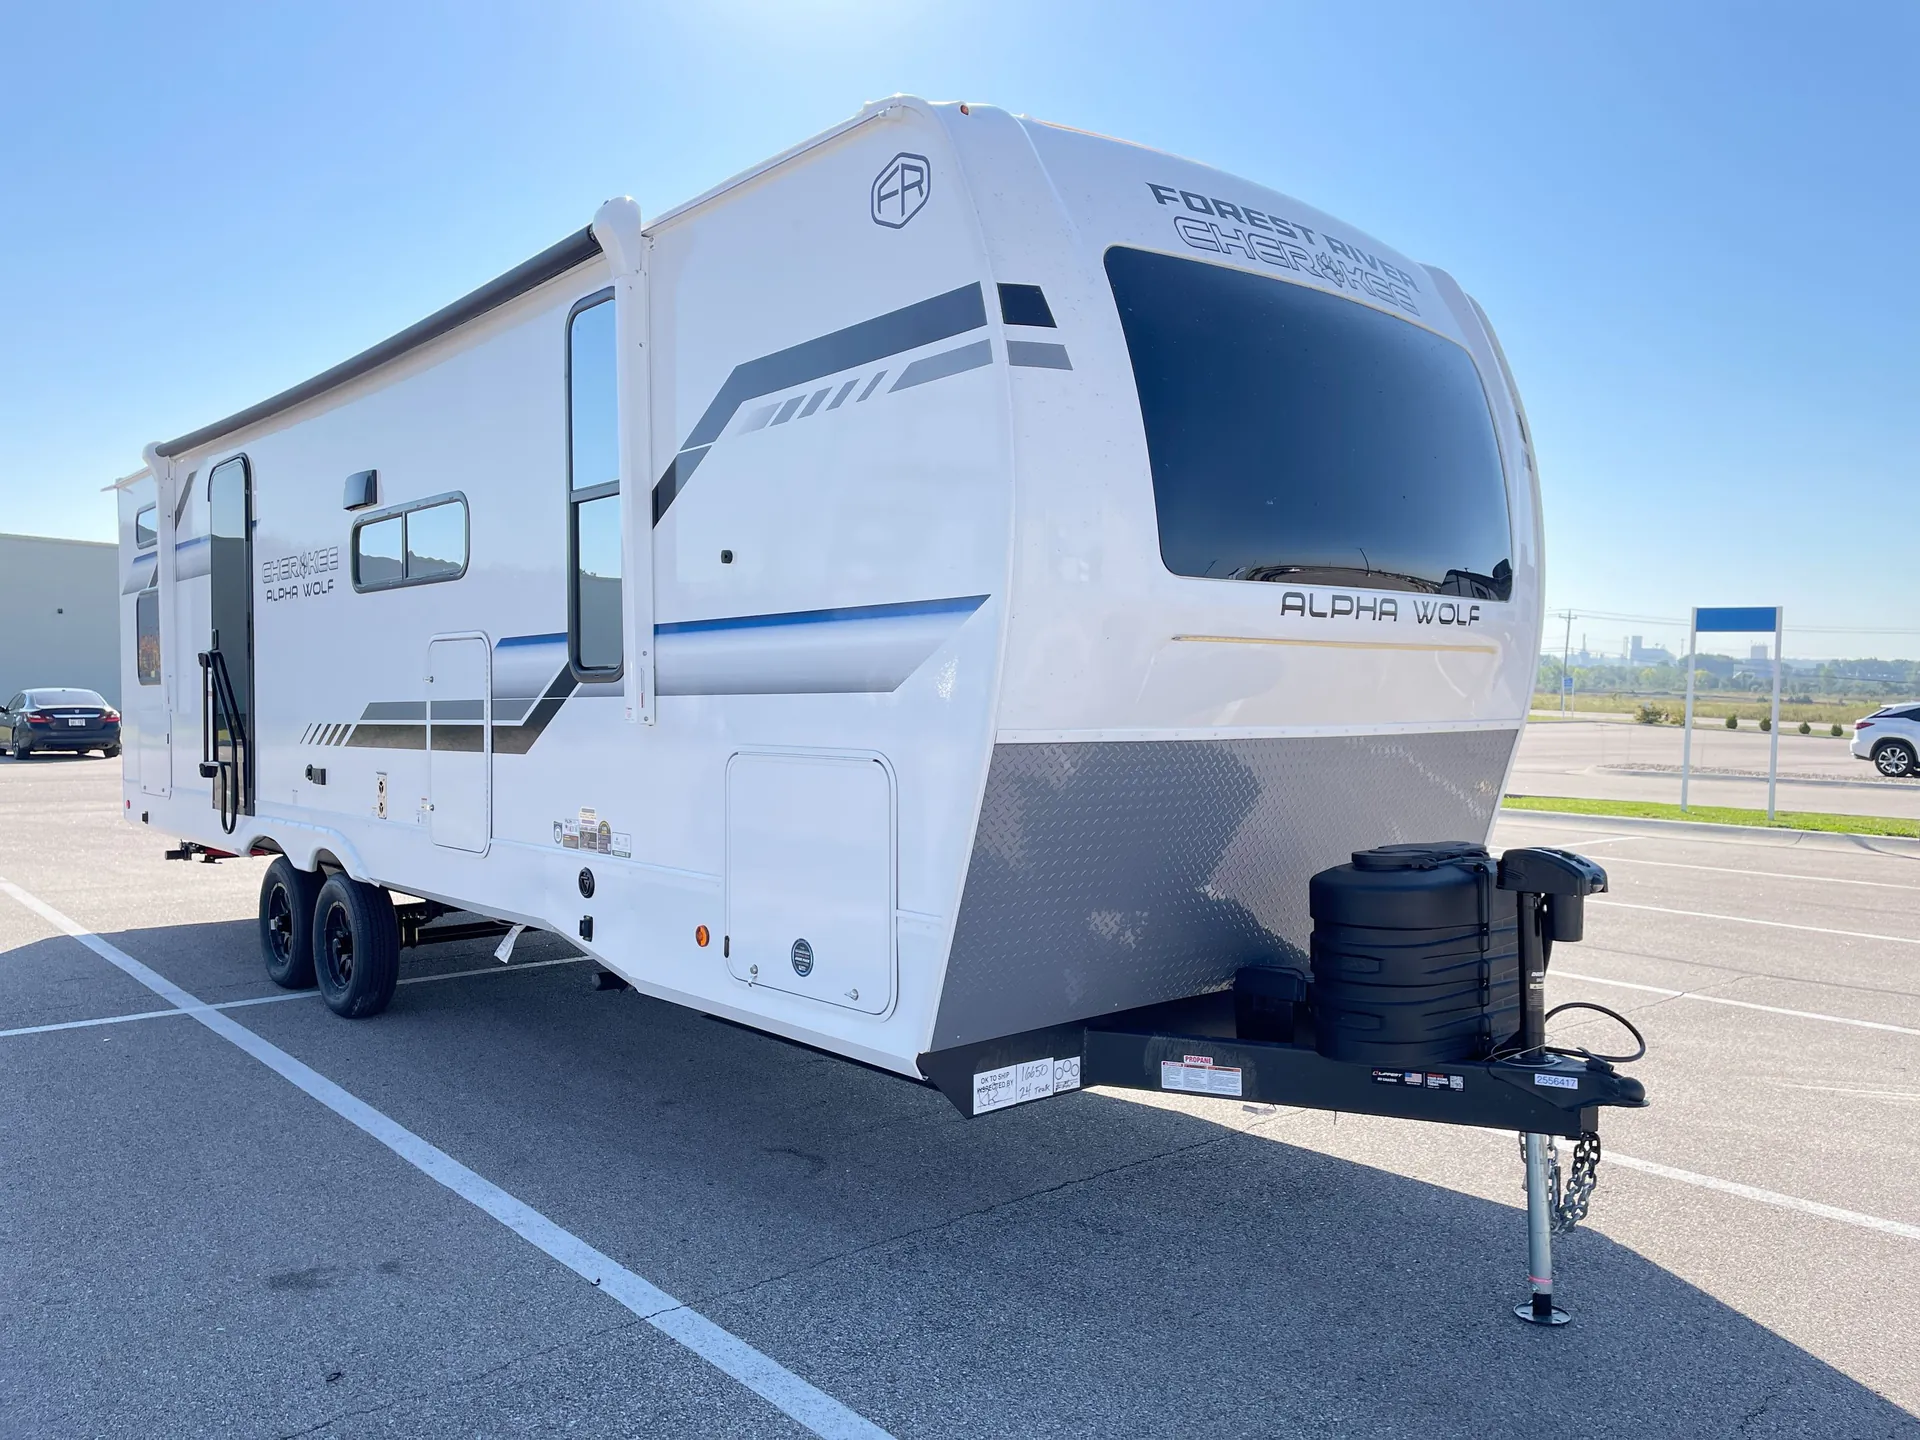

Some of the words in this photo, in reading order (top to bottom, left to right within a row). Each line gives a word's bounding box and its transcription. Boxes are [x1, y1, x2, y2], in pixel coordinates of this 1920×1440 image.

[1145, 182, 1316, 245] FOREST
[1321, 233, 1421, 293] RIVER
[266, 585, 298, 602] ALPHA
[303, 579, 334, 597] WOLF
[1280, 591, 1398, 622] ALPHA
[1413, 600, 1480, 626] WOLF
[1185, 1056, 1211, 1064] PROPANE
[998, 1071, 1010, 1080] SHIP
[1536, 1075, 1577, 1087] 2556417
[1007, 1079, 1014, 1087] BY
